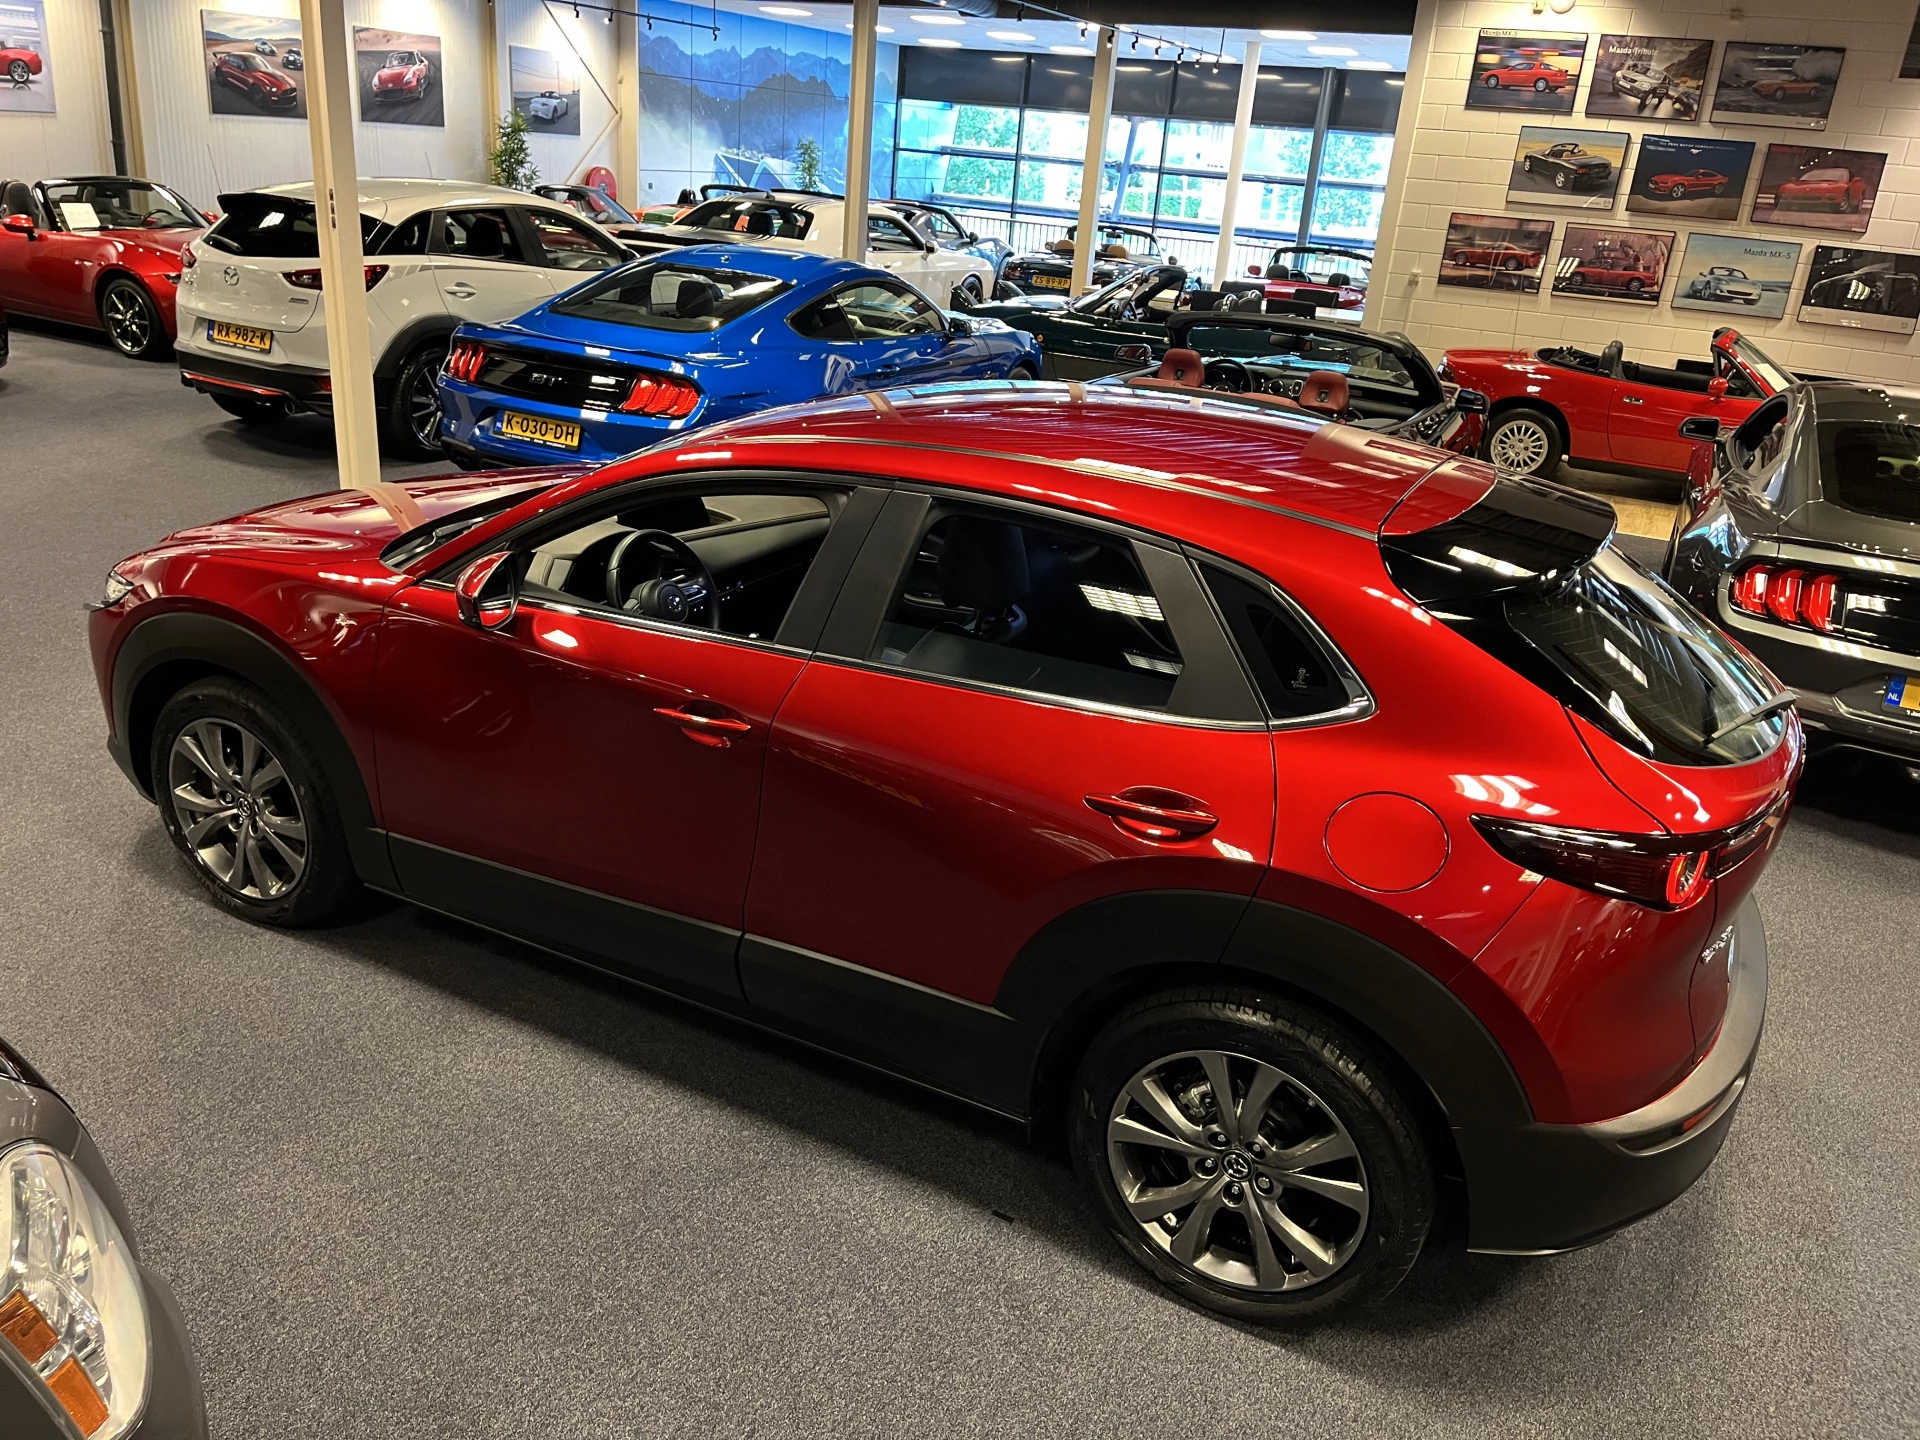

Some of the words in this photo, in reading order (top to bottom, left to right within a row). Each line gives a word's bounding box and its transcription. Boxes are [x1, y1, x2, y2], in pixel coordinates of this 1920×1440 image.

[1482, 29, 1501, 37] Mazda
[1609, 45, 1632, 54] Mazda
[1744, 248, 1767, 257] Mazda
[1769, 250, 1791, 260] MX-5
[1034, 276, 1068, 286] ZS-89-RP
[216, 323, 267, 347] RX-982-K
[505, 413, 576, 443] K-030-DH
[1887, 692, 1900, 701] NL
